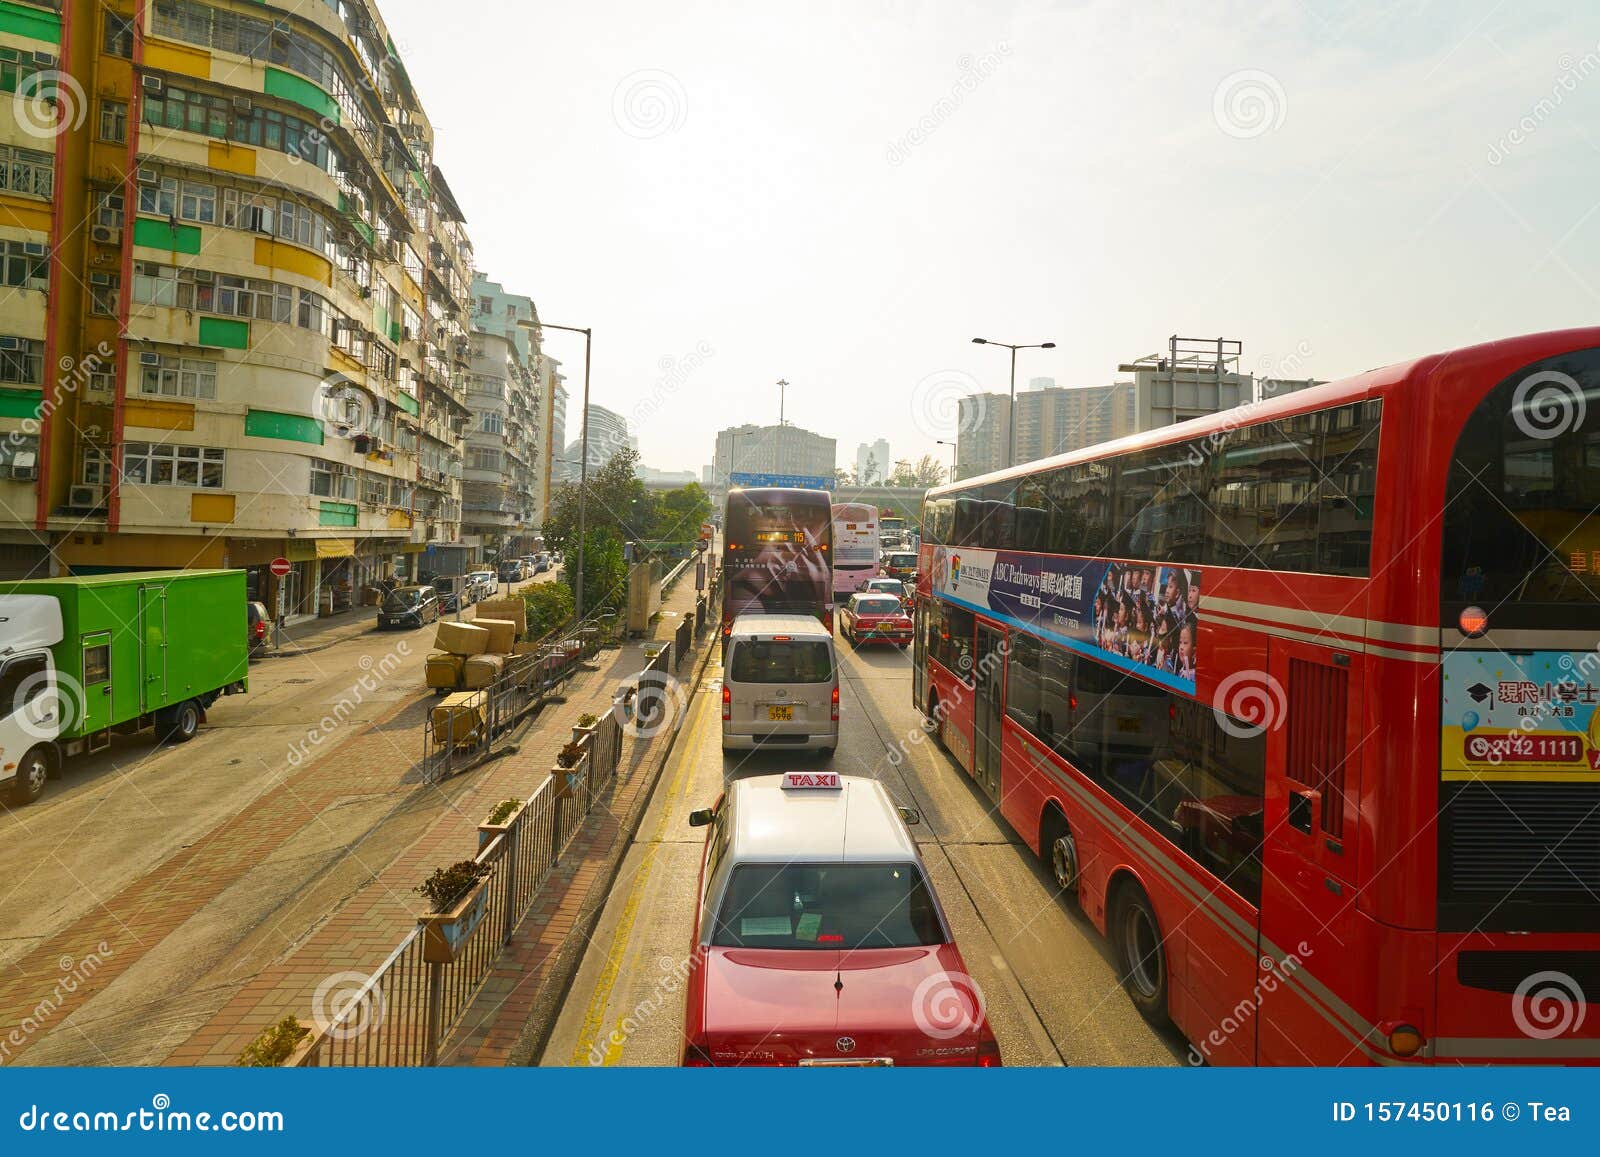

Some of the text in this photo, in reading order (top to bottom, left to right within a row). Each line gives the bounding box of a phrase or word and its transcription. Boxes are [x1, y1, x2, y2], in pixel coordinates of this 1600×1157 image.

[793, 532, 804, 542] 115
[994, 562, 1010, 582] ABC
[1009, 564, 1040, 593] Pathways
[1041, 571, 1083, 600] 國際幼稚園
[1493, 740, 1577, 755] 2142 1111
[788, 774, 836, 786] TAXI
